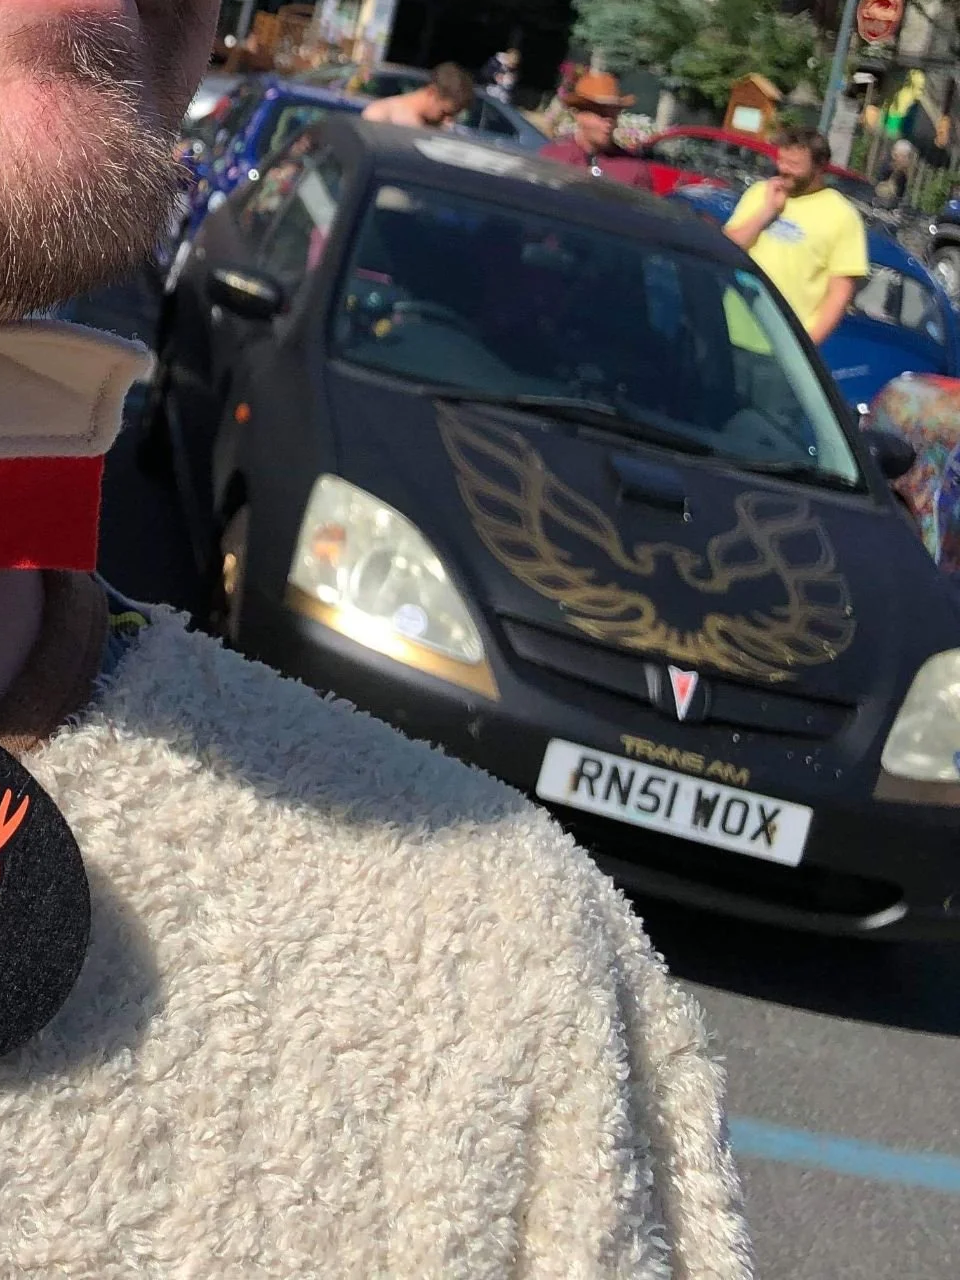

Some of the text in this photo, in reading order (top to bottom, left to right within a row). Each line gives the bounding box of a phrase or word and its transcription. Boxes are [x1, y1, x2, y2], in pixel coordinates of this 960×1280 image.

[619, 734, 750, 786] TRANS AM
[572, 756, 781, 846] RN51 WOX
